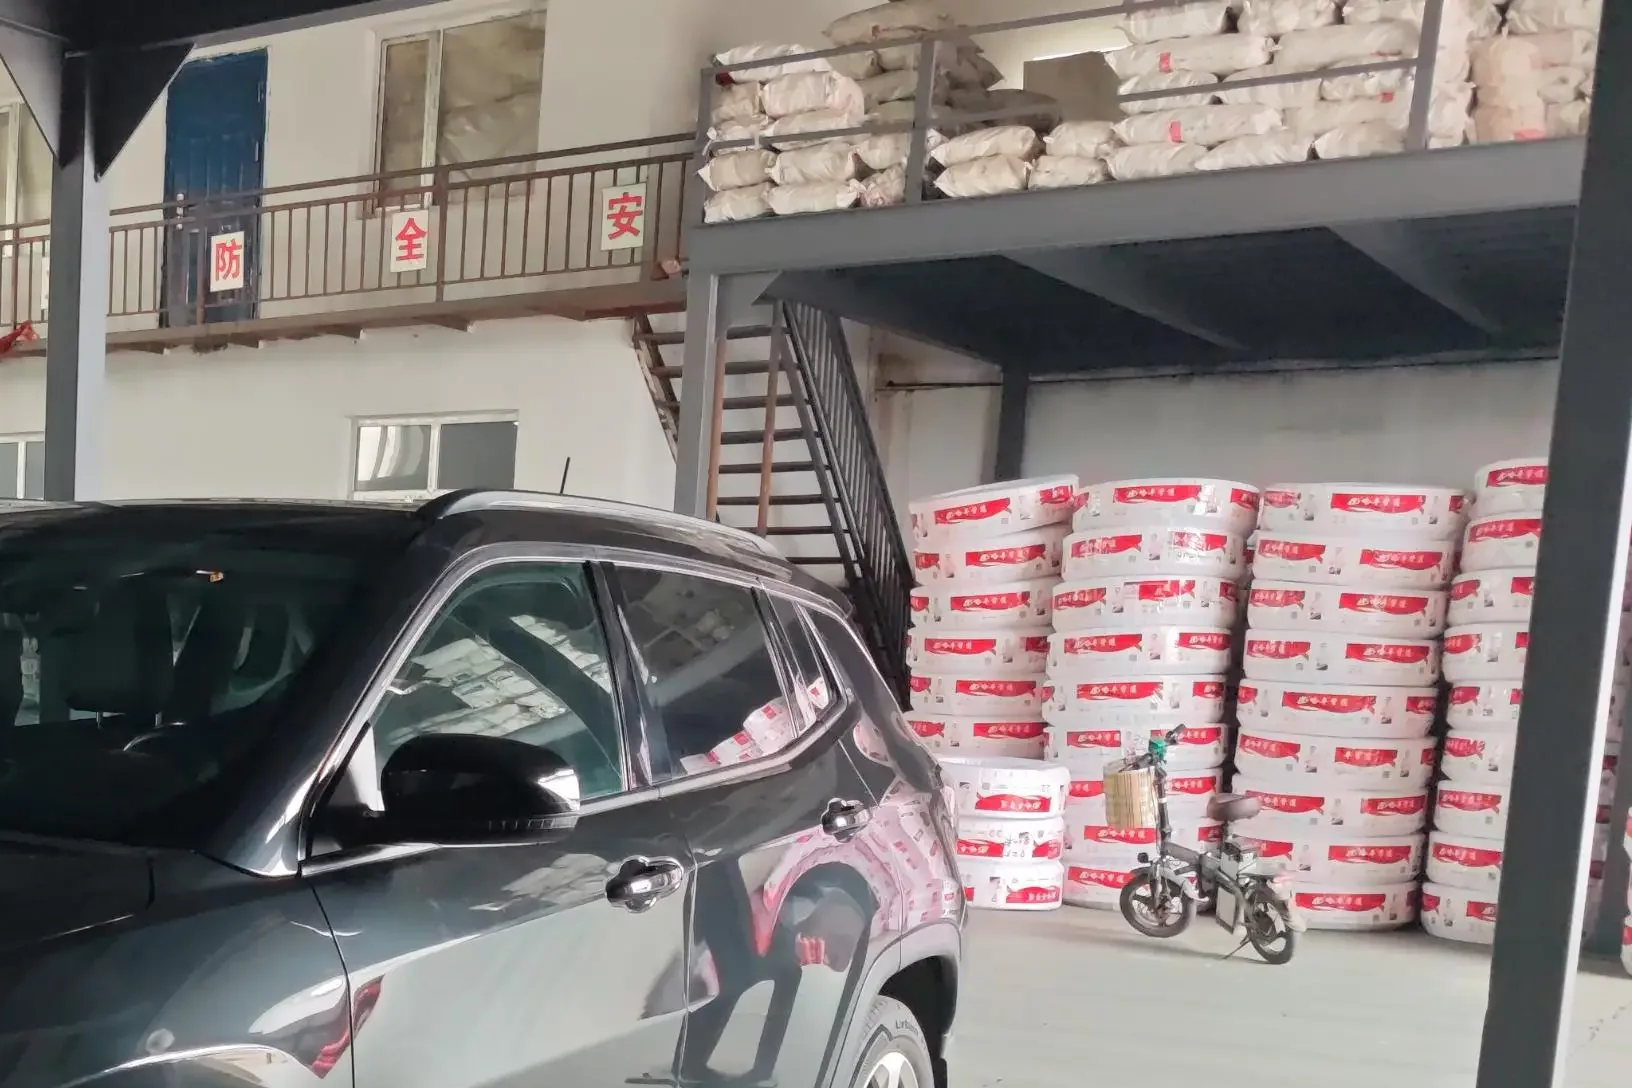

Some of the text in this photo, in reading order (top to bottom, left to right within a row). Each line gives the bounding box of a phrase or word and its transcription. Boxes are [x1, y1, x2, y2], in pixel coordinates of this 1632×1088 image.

[607, 192, 643, 240] 安
[215, 239, 243, 281] 防
[395, 217, 427, 262] 全
